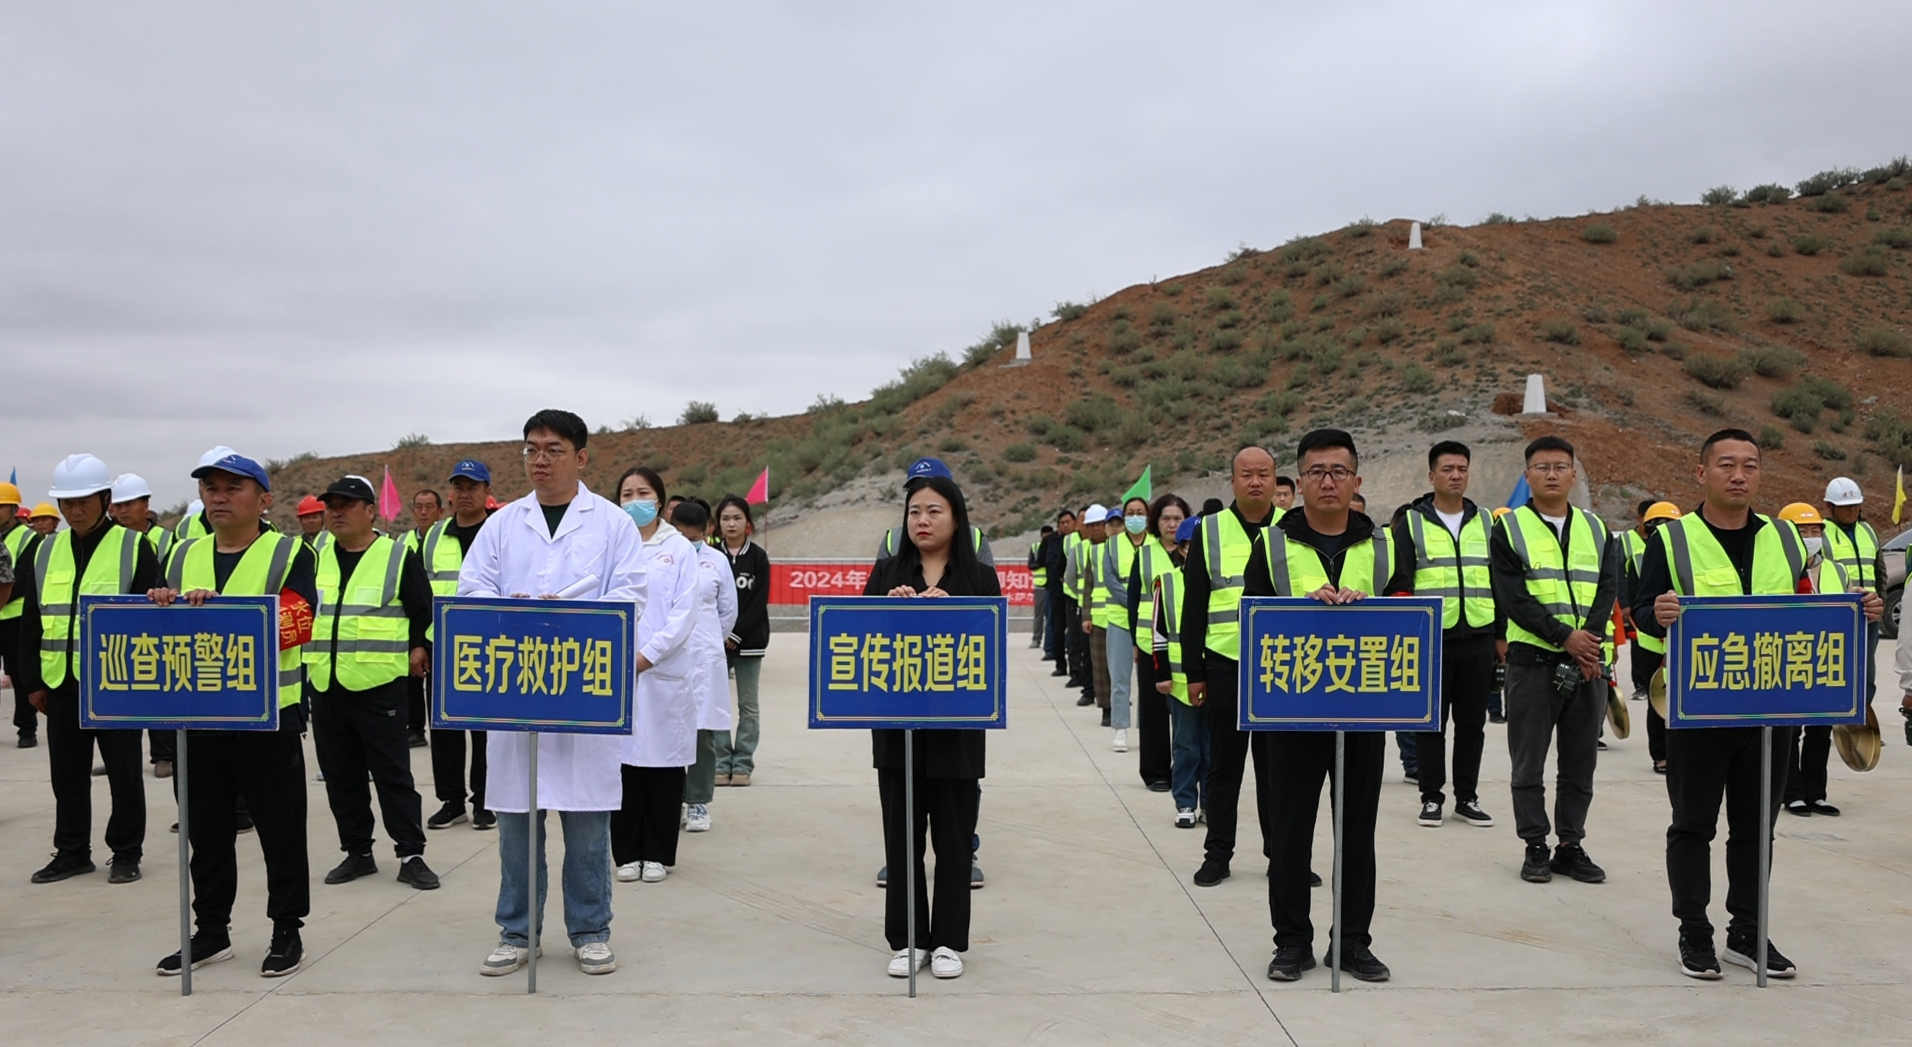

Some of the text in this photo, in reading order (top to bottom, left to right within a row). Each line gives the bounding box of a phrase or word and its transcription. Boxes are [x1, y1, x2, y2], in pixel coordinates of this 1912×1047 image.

[790, 569, 870, 590] 2024年
[99, 632, 257, 692] 巡查预警组
[452, 634, 613, 696] 医疗救护组
[828, 632, 987, 693] 宣传报道组
[1260, 633, 1420, 694] 转移安置组
[1689, 631, 1846, 691] 应急撤离组
